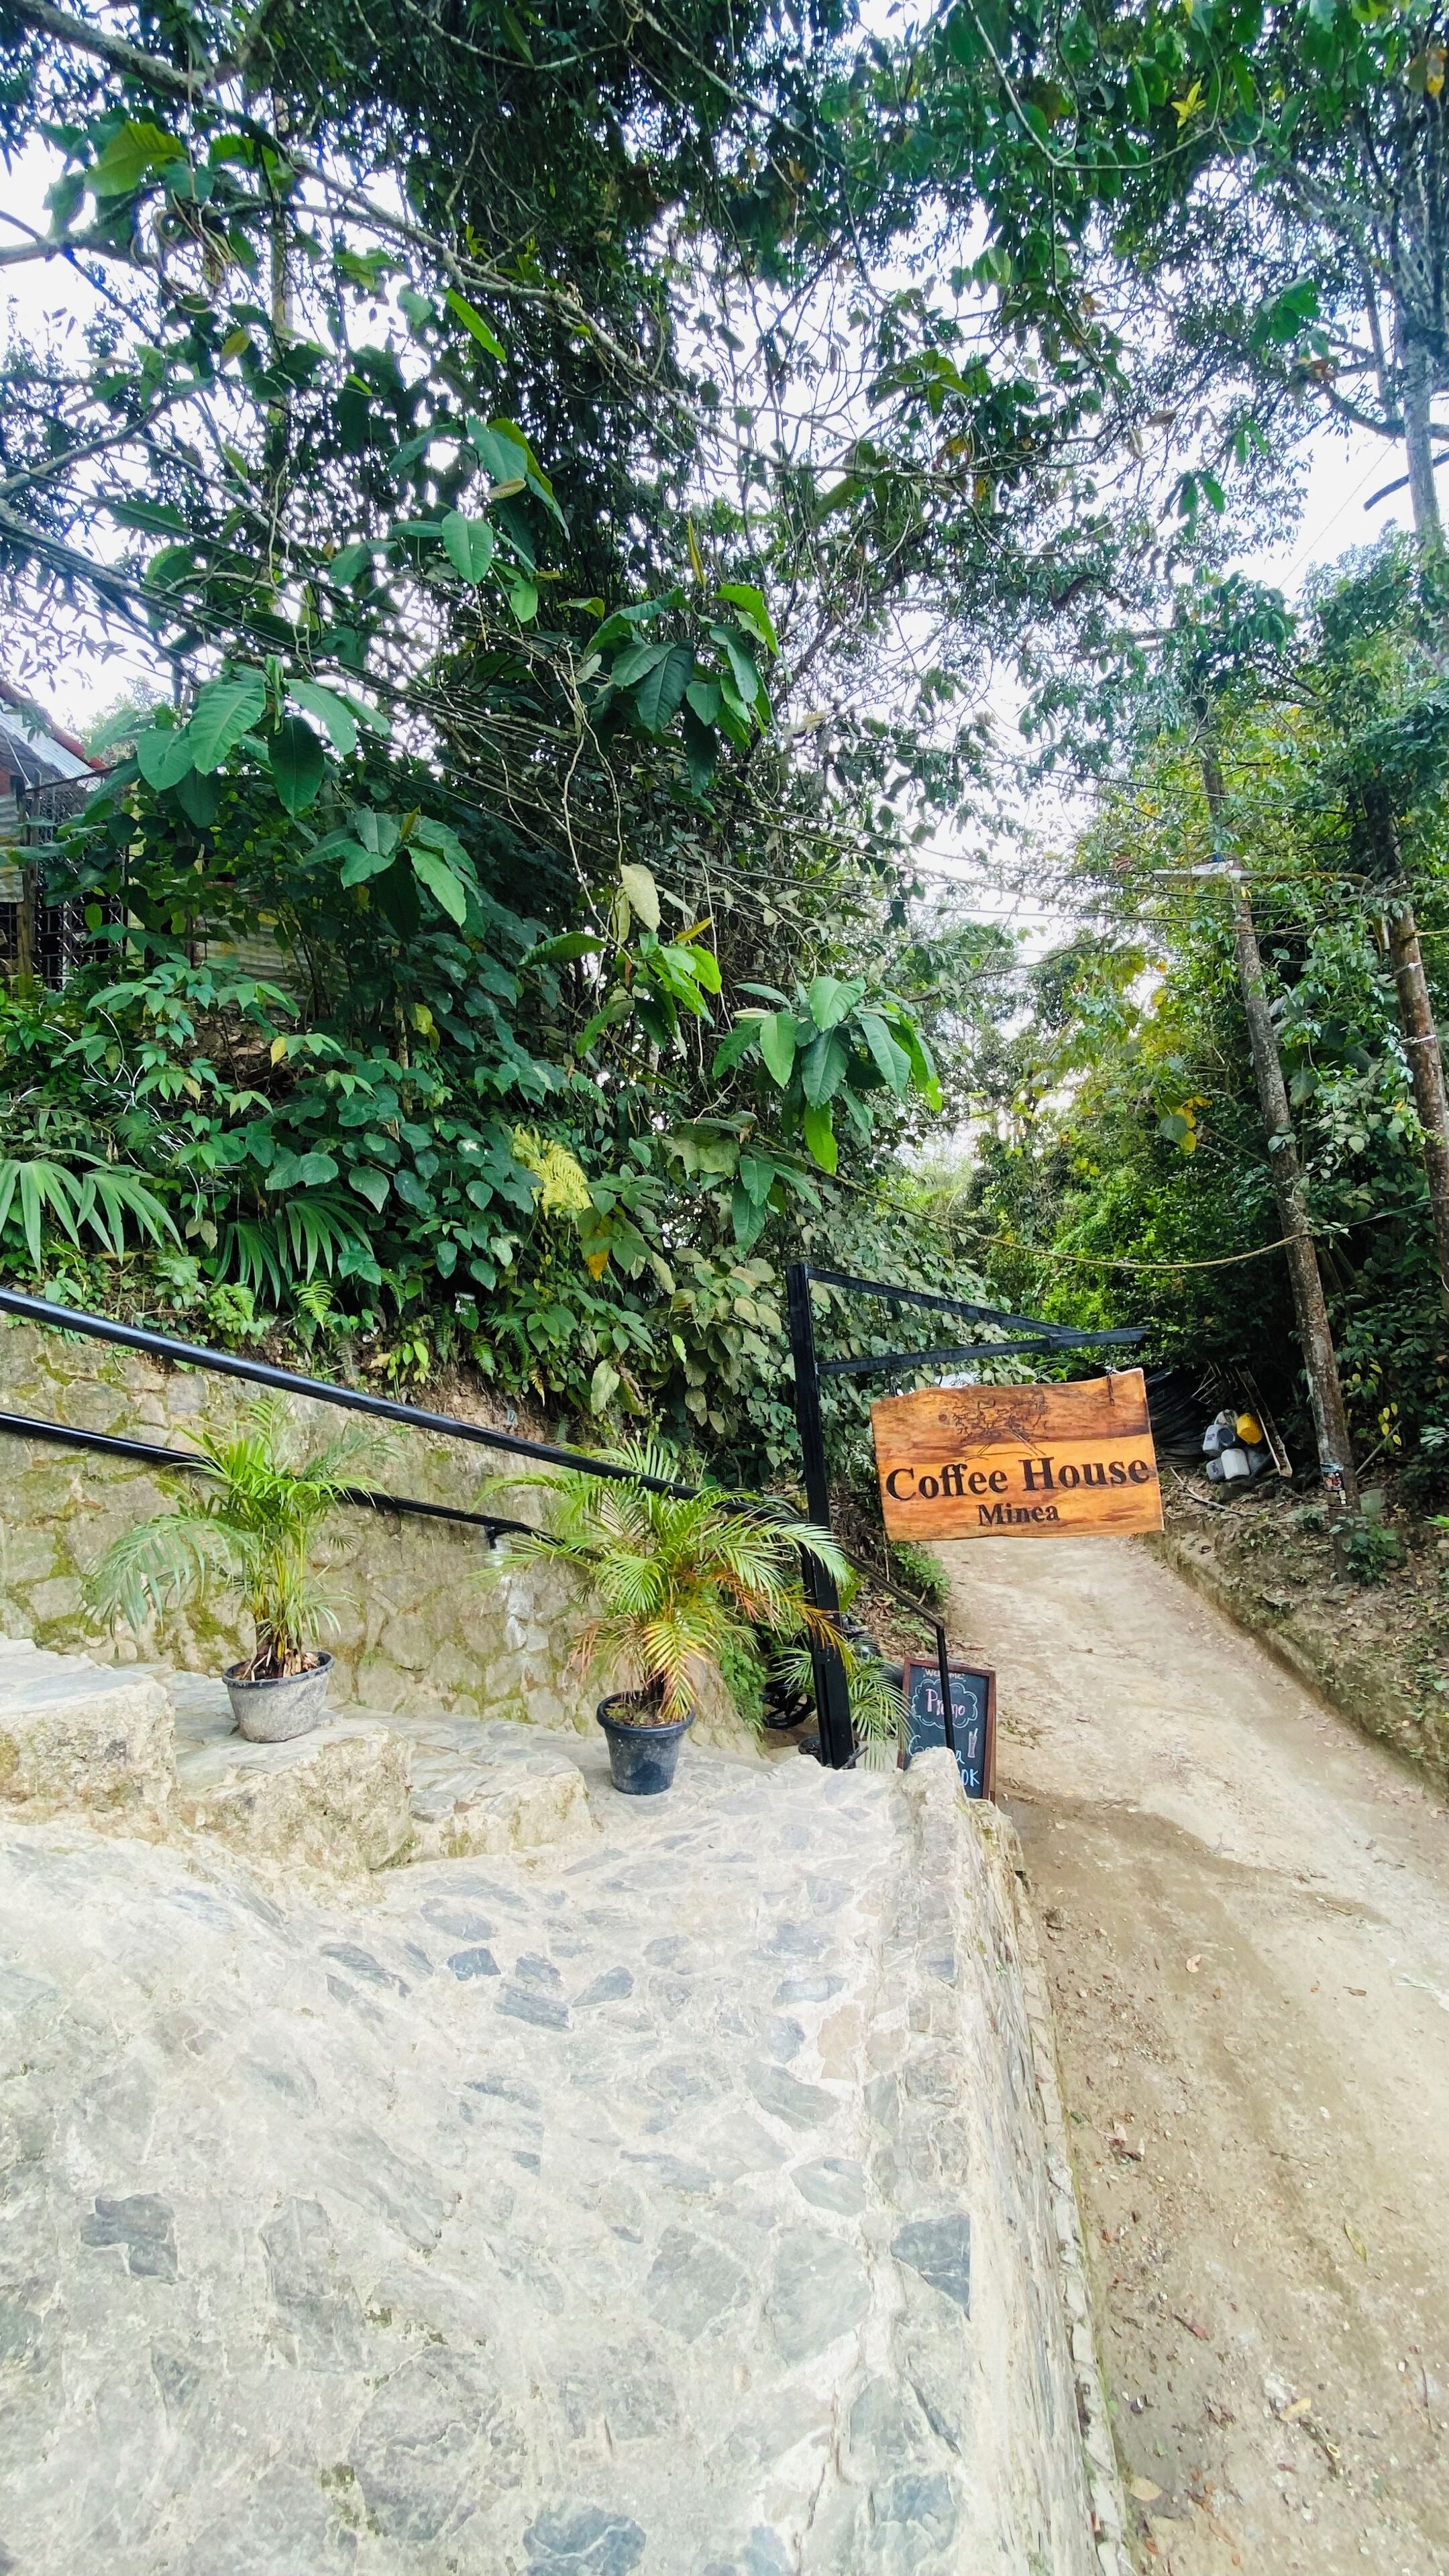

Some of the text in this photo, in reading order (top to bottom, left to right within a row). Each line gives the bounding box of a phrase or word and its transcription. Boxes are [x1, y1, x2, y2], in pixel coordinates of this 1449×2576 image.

[885, 1456, 1150, 1501] Coffee House
[924, 1668, 965, 1680] Welme
